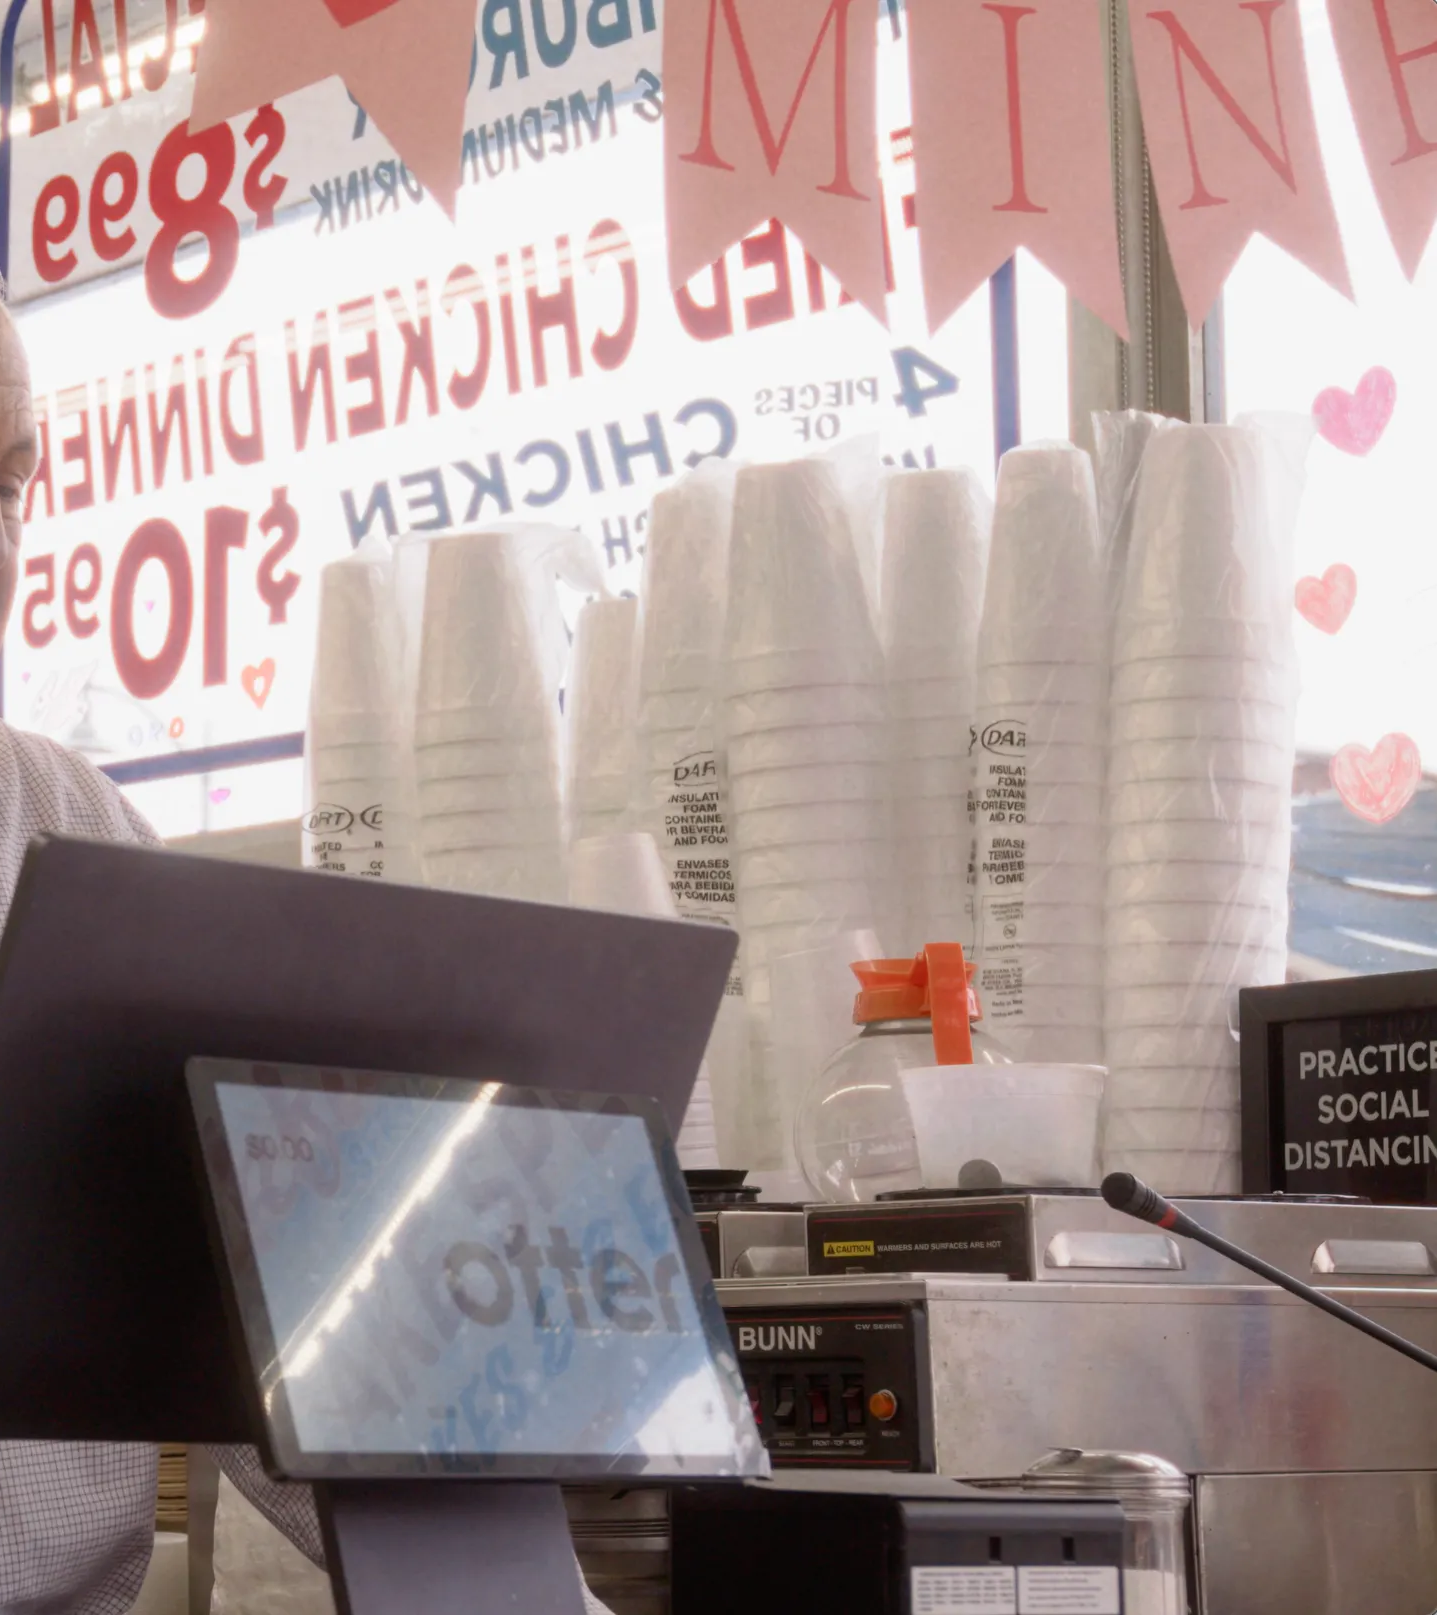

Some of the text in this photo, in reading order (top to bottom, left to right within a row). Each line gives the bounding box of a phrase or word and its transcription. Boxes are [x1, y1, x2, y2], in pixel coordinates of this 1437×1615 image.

[677, 859, 730, 869] ENVASES
[1317, 1089, 1430, 1124] SOCIAL
[836, 1240, 1002, 1255] CAUTION WARMERS AND SURFACES ARE HOT
